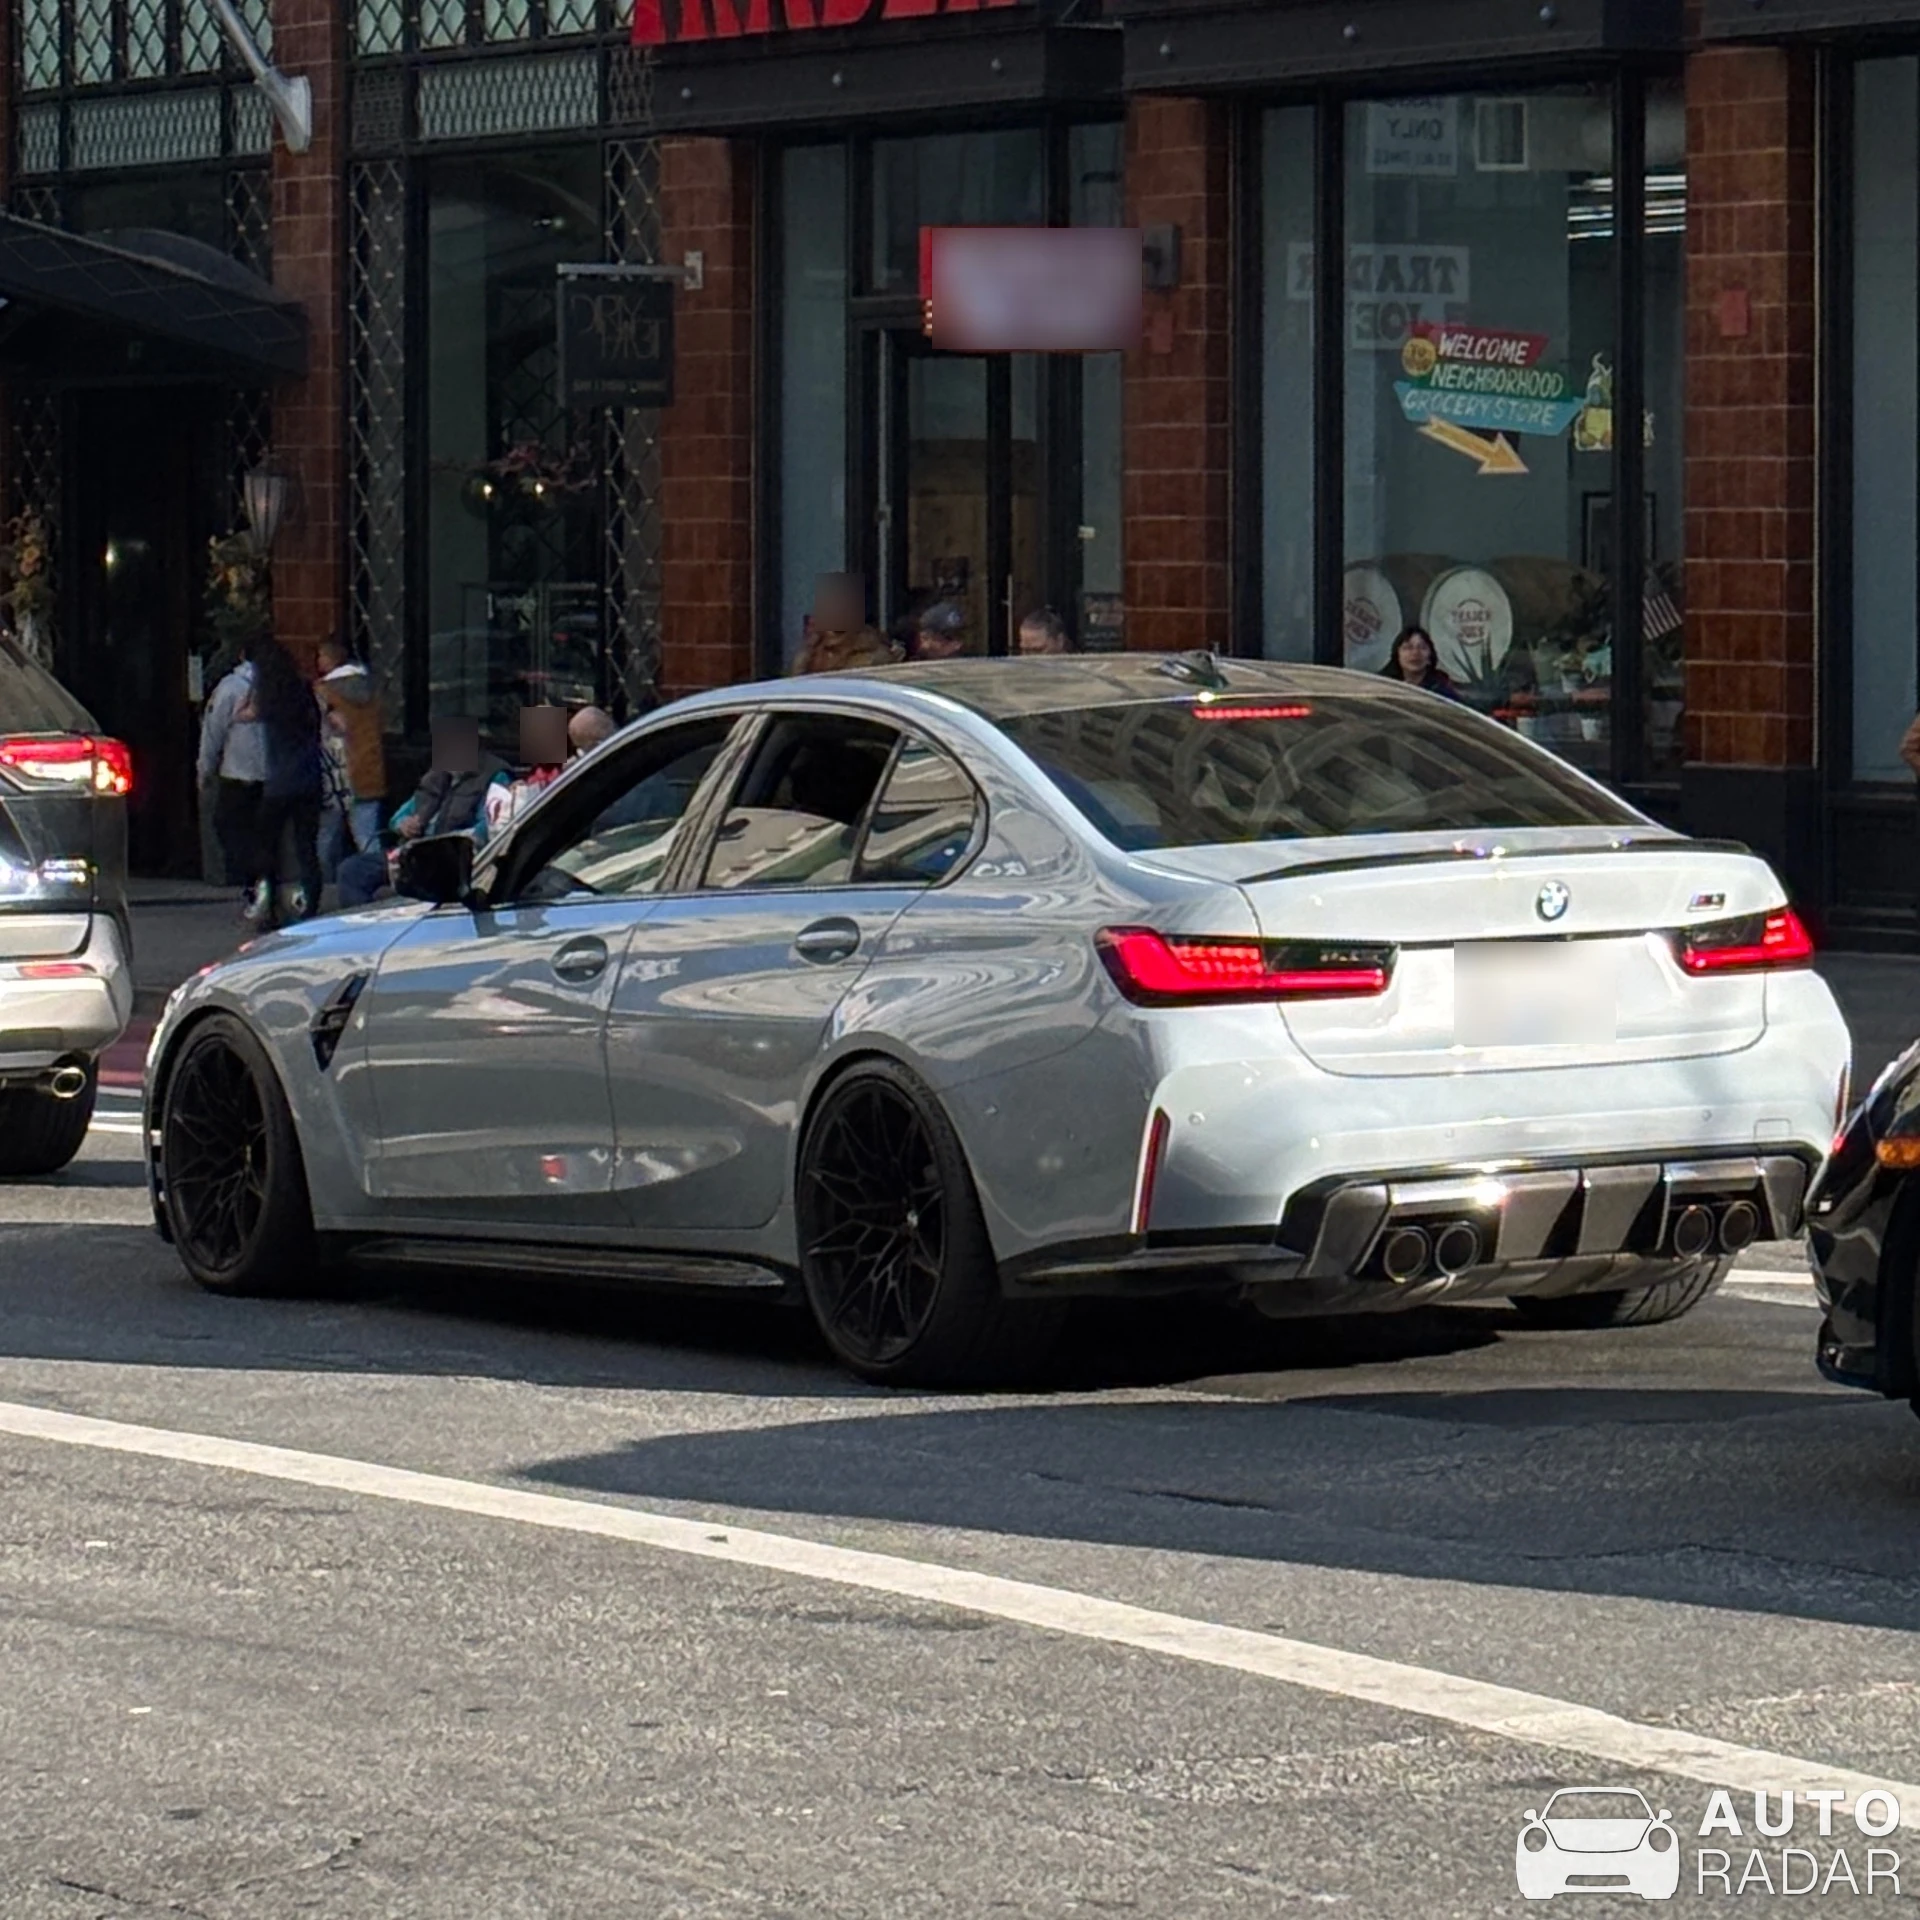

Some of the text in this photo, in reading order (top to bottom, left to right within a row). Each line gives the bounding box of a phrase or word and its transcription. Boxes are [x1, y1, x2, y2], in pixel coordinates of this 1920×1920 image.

[1438, 331, 1530, 366] WELCOME
[1429, 362, 1564, 399] NEIGHBORHOOD
[1403, 388, 1557, 427] GROCERY STORE
